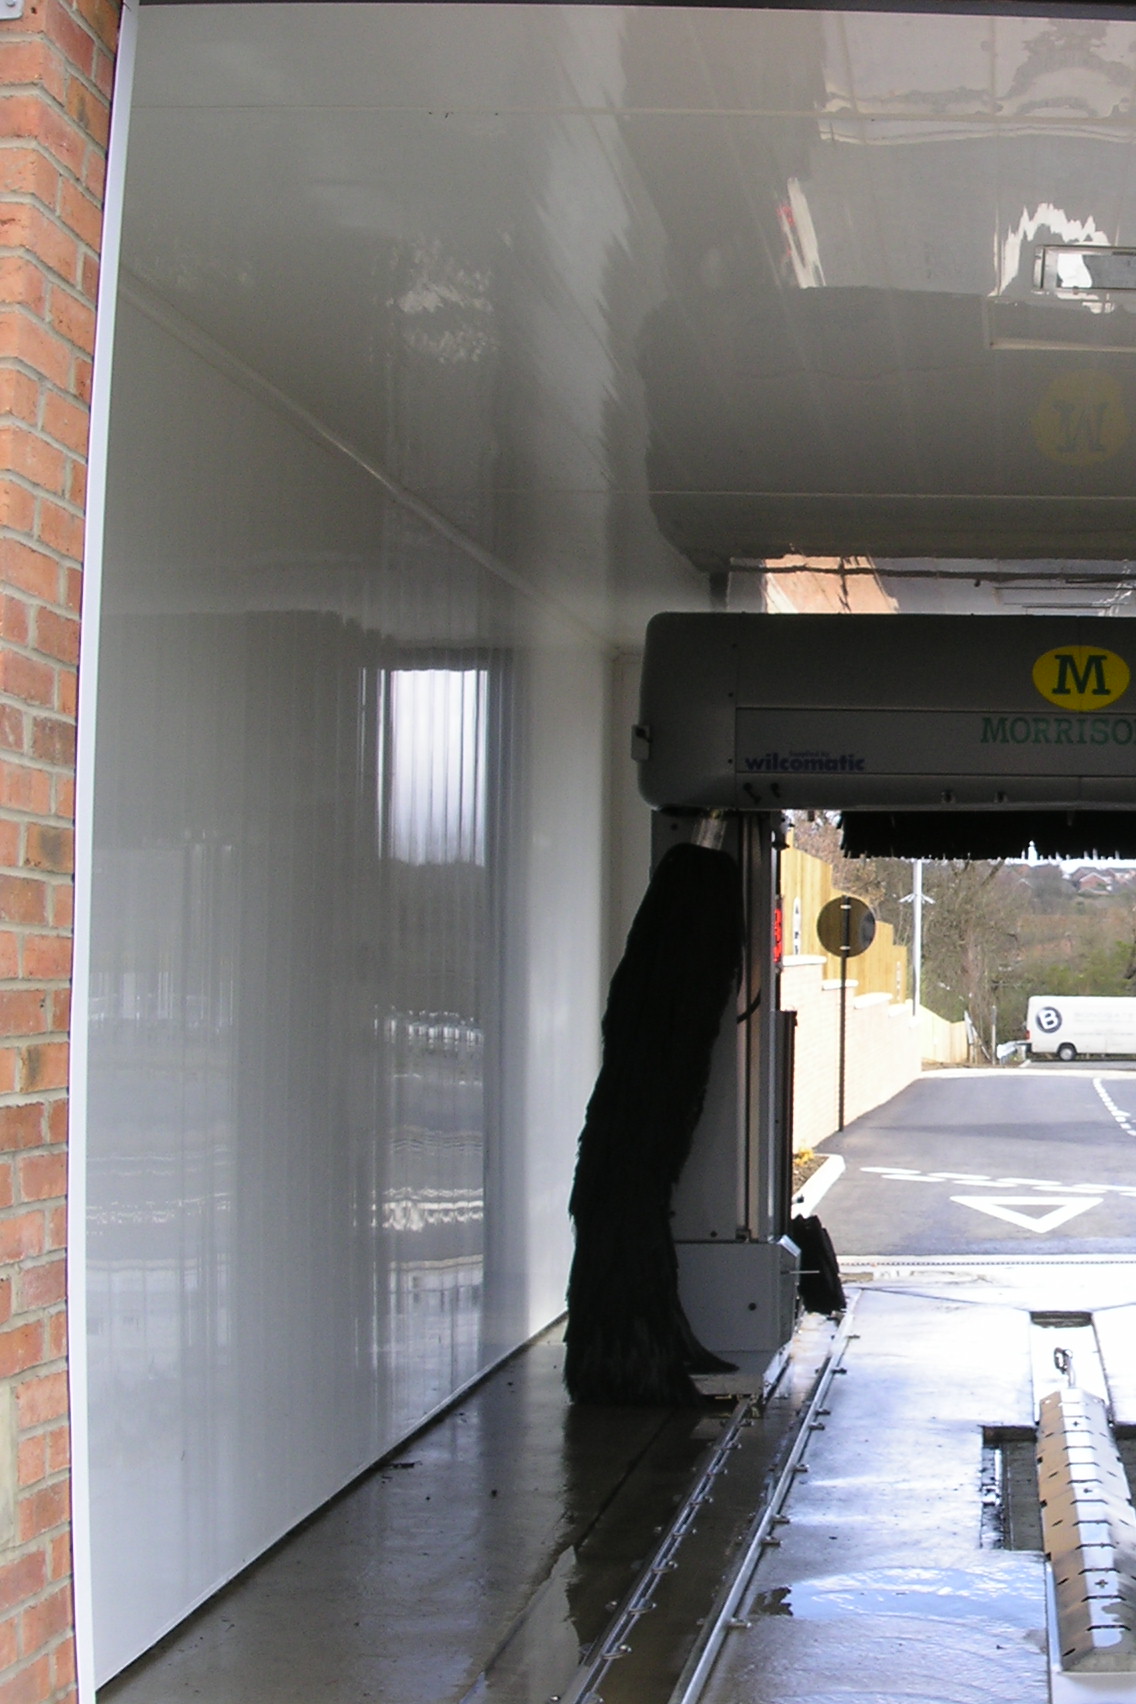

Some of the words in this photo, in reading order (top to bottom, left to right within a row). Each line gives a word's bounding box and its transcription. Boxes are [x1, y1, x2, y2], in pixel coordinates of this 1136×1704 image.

[1050, 654, 1112, 696] M
[744, 752, 866, 772] wilcomatic
[1037, 1008, 1059, 1030] B
